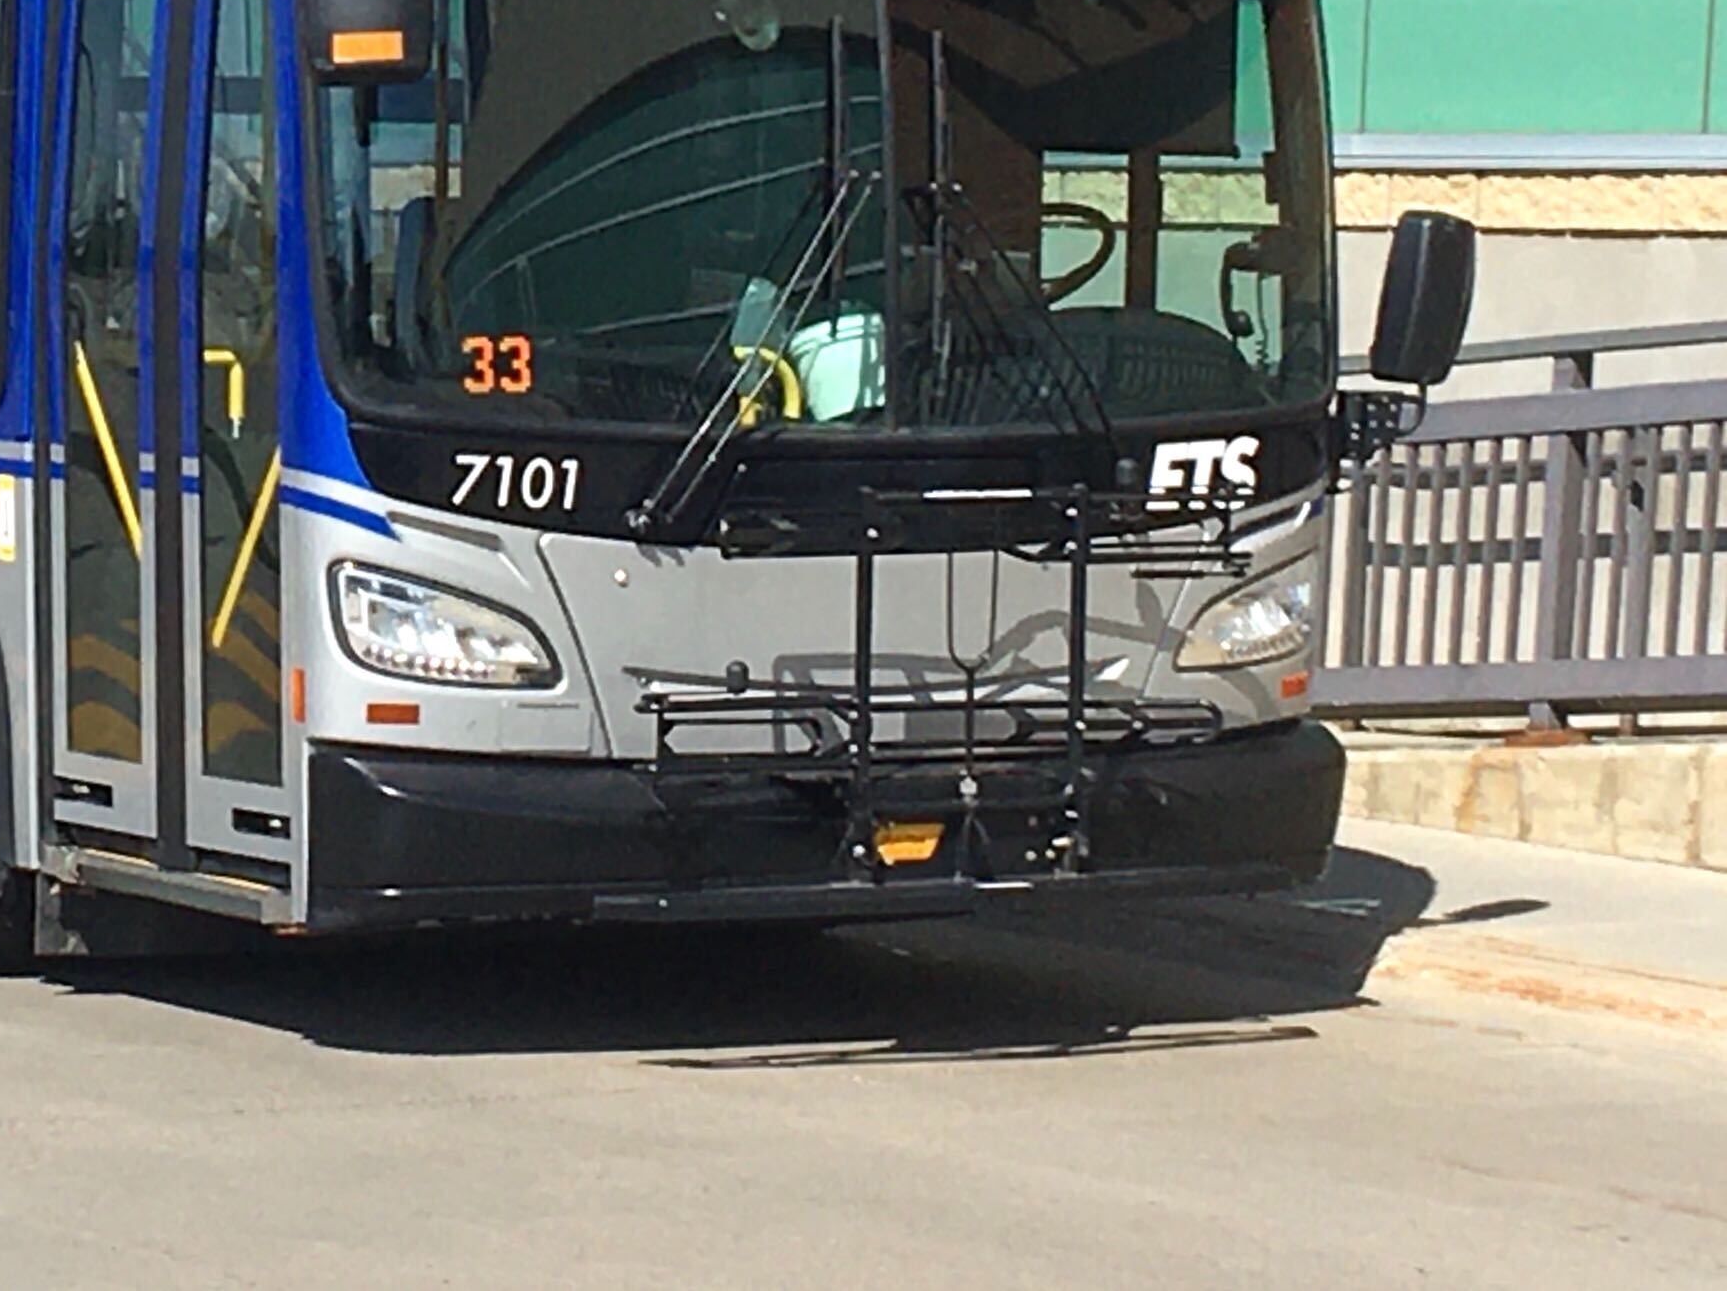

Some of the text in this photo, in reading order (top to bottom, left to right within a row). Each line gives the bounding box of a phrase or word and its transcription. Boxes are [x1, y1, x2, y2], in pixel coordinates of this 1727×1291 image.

[460, 335, 534, 395] 33
[451, 454, 580, 510] 7101
[1145, 434, 1260, 511] ETS
